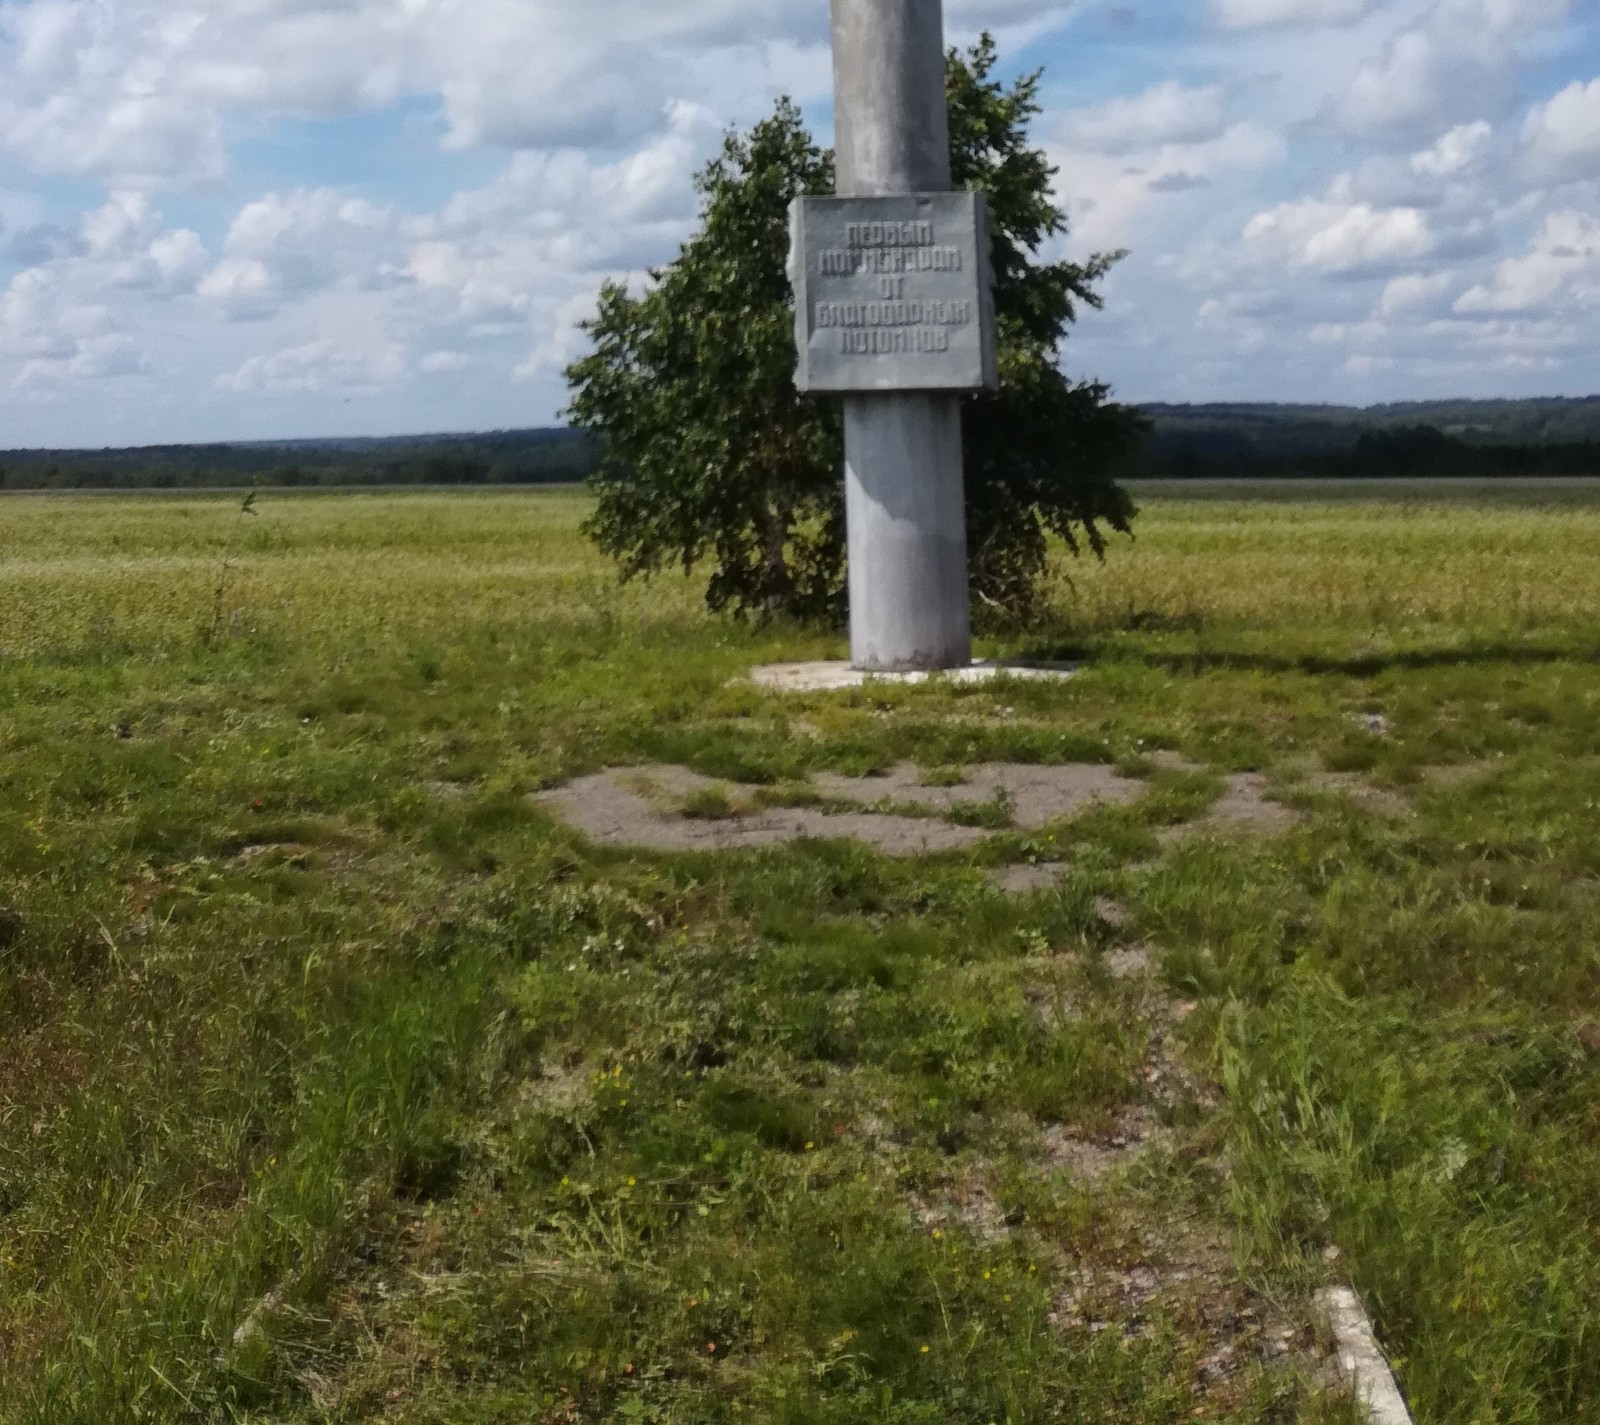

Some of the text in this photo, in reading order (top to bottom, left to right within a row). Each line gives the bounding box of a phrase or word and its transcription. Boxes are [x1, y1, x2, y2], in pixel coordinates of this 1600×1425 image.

[845, 219, 934, 246] ПЕРВЫМ
[878, 274, 904, 299] ОТ
[841, 327, 948, 354] ПОТОМКОВ
